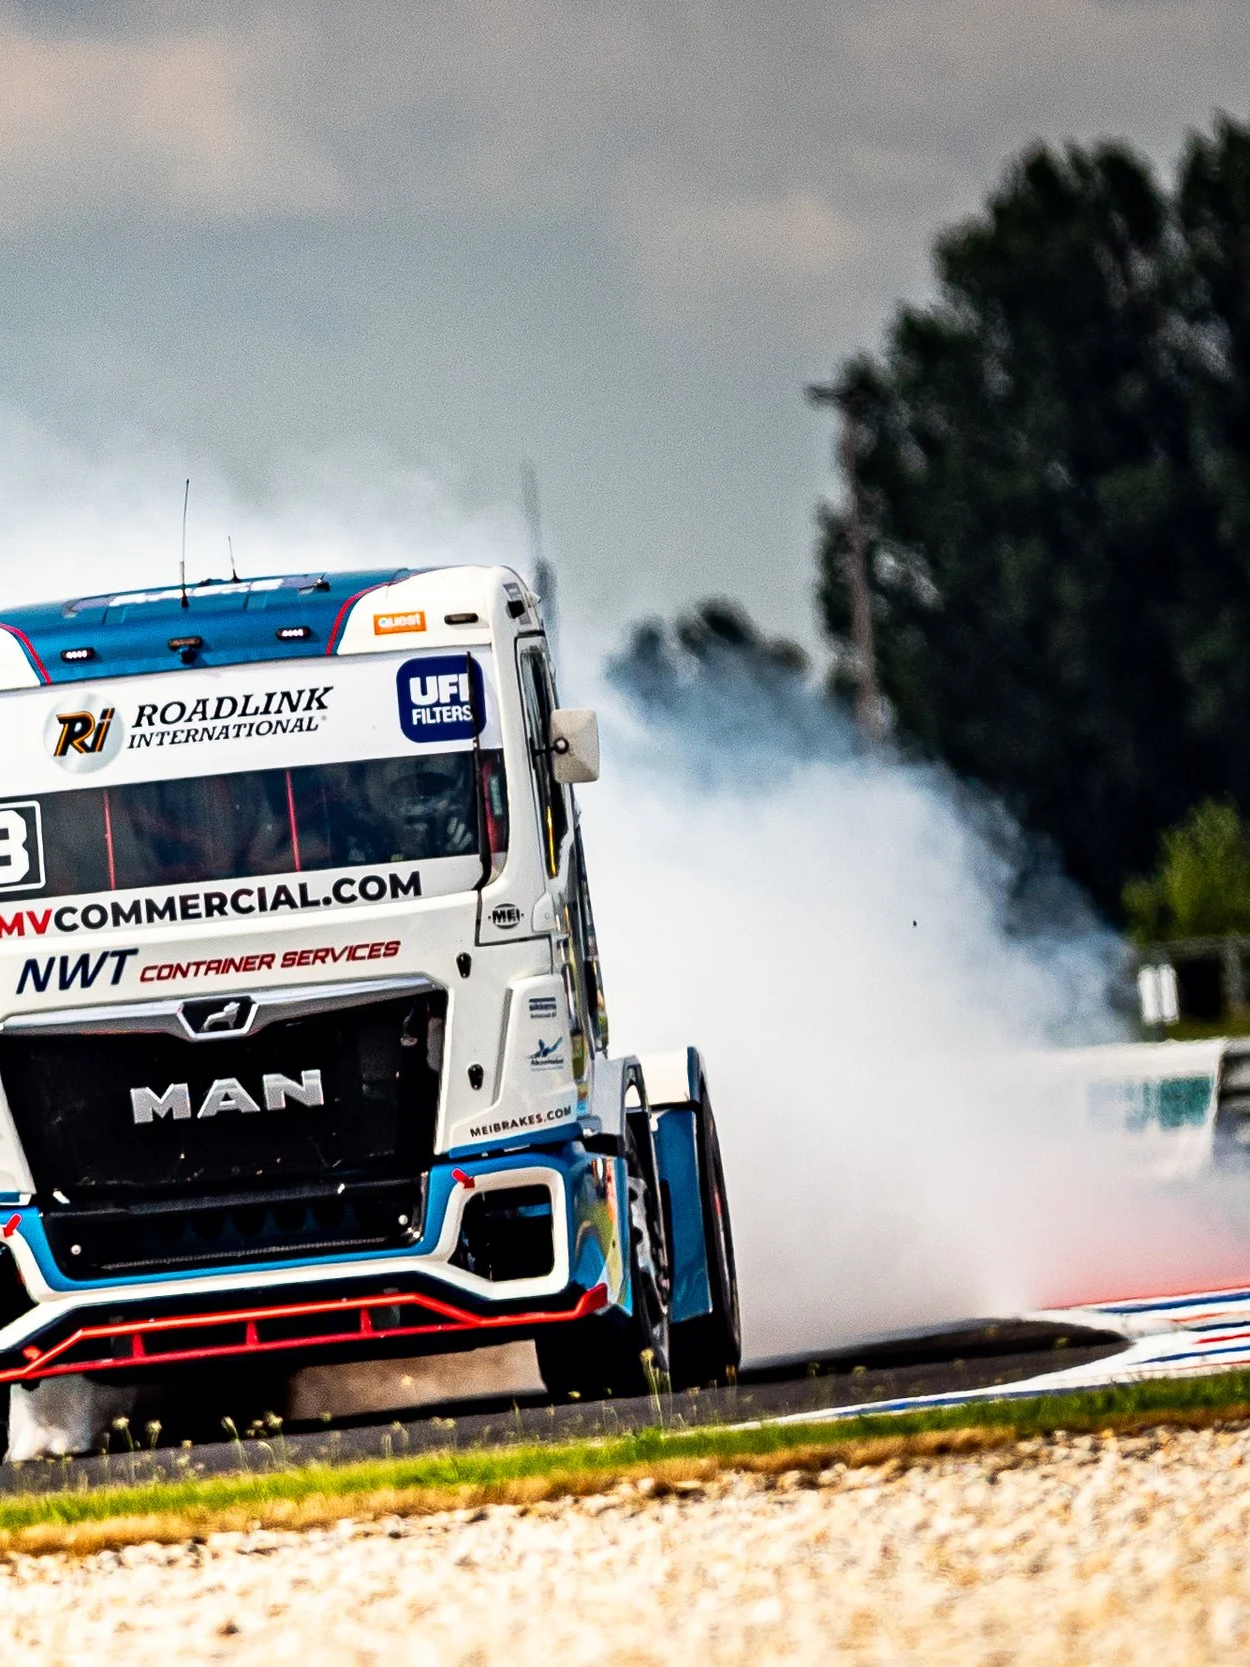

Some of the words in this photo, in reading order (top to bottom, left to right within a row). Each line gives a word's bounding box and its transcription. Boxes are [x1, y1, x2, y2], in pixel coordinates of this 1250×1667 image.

[409, 673, 470, 706] UFI
[131, 686, 335, 729] ROADLINK
[411, 704, 473, 726] FILTERS
[127, 716, 320, 750] INTERNATIONAL
[15, 948, 139, 995] NWT
[139, 954, 277, 984] CONTAINER
[280, 940, 402, 969] SERVICES
[130, 1068, 324, 1125] MAN
[469, 1105, 573, 1138] MEIBRAKES.COM
